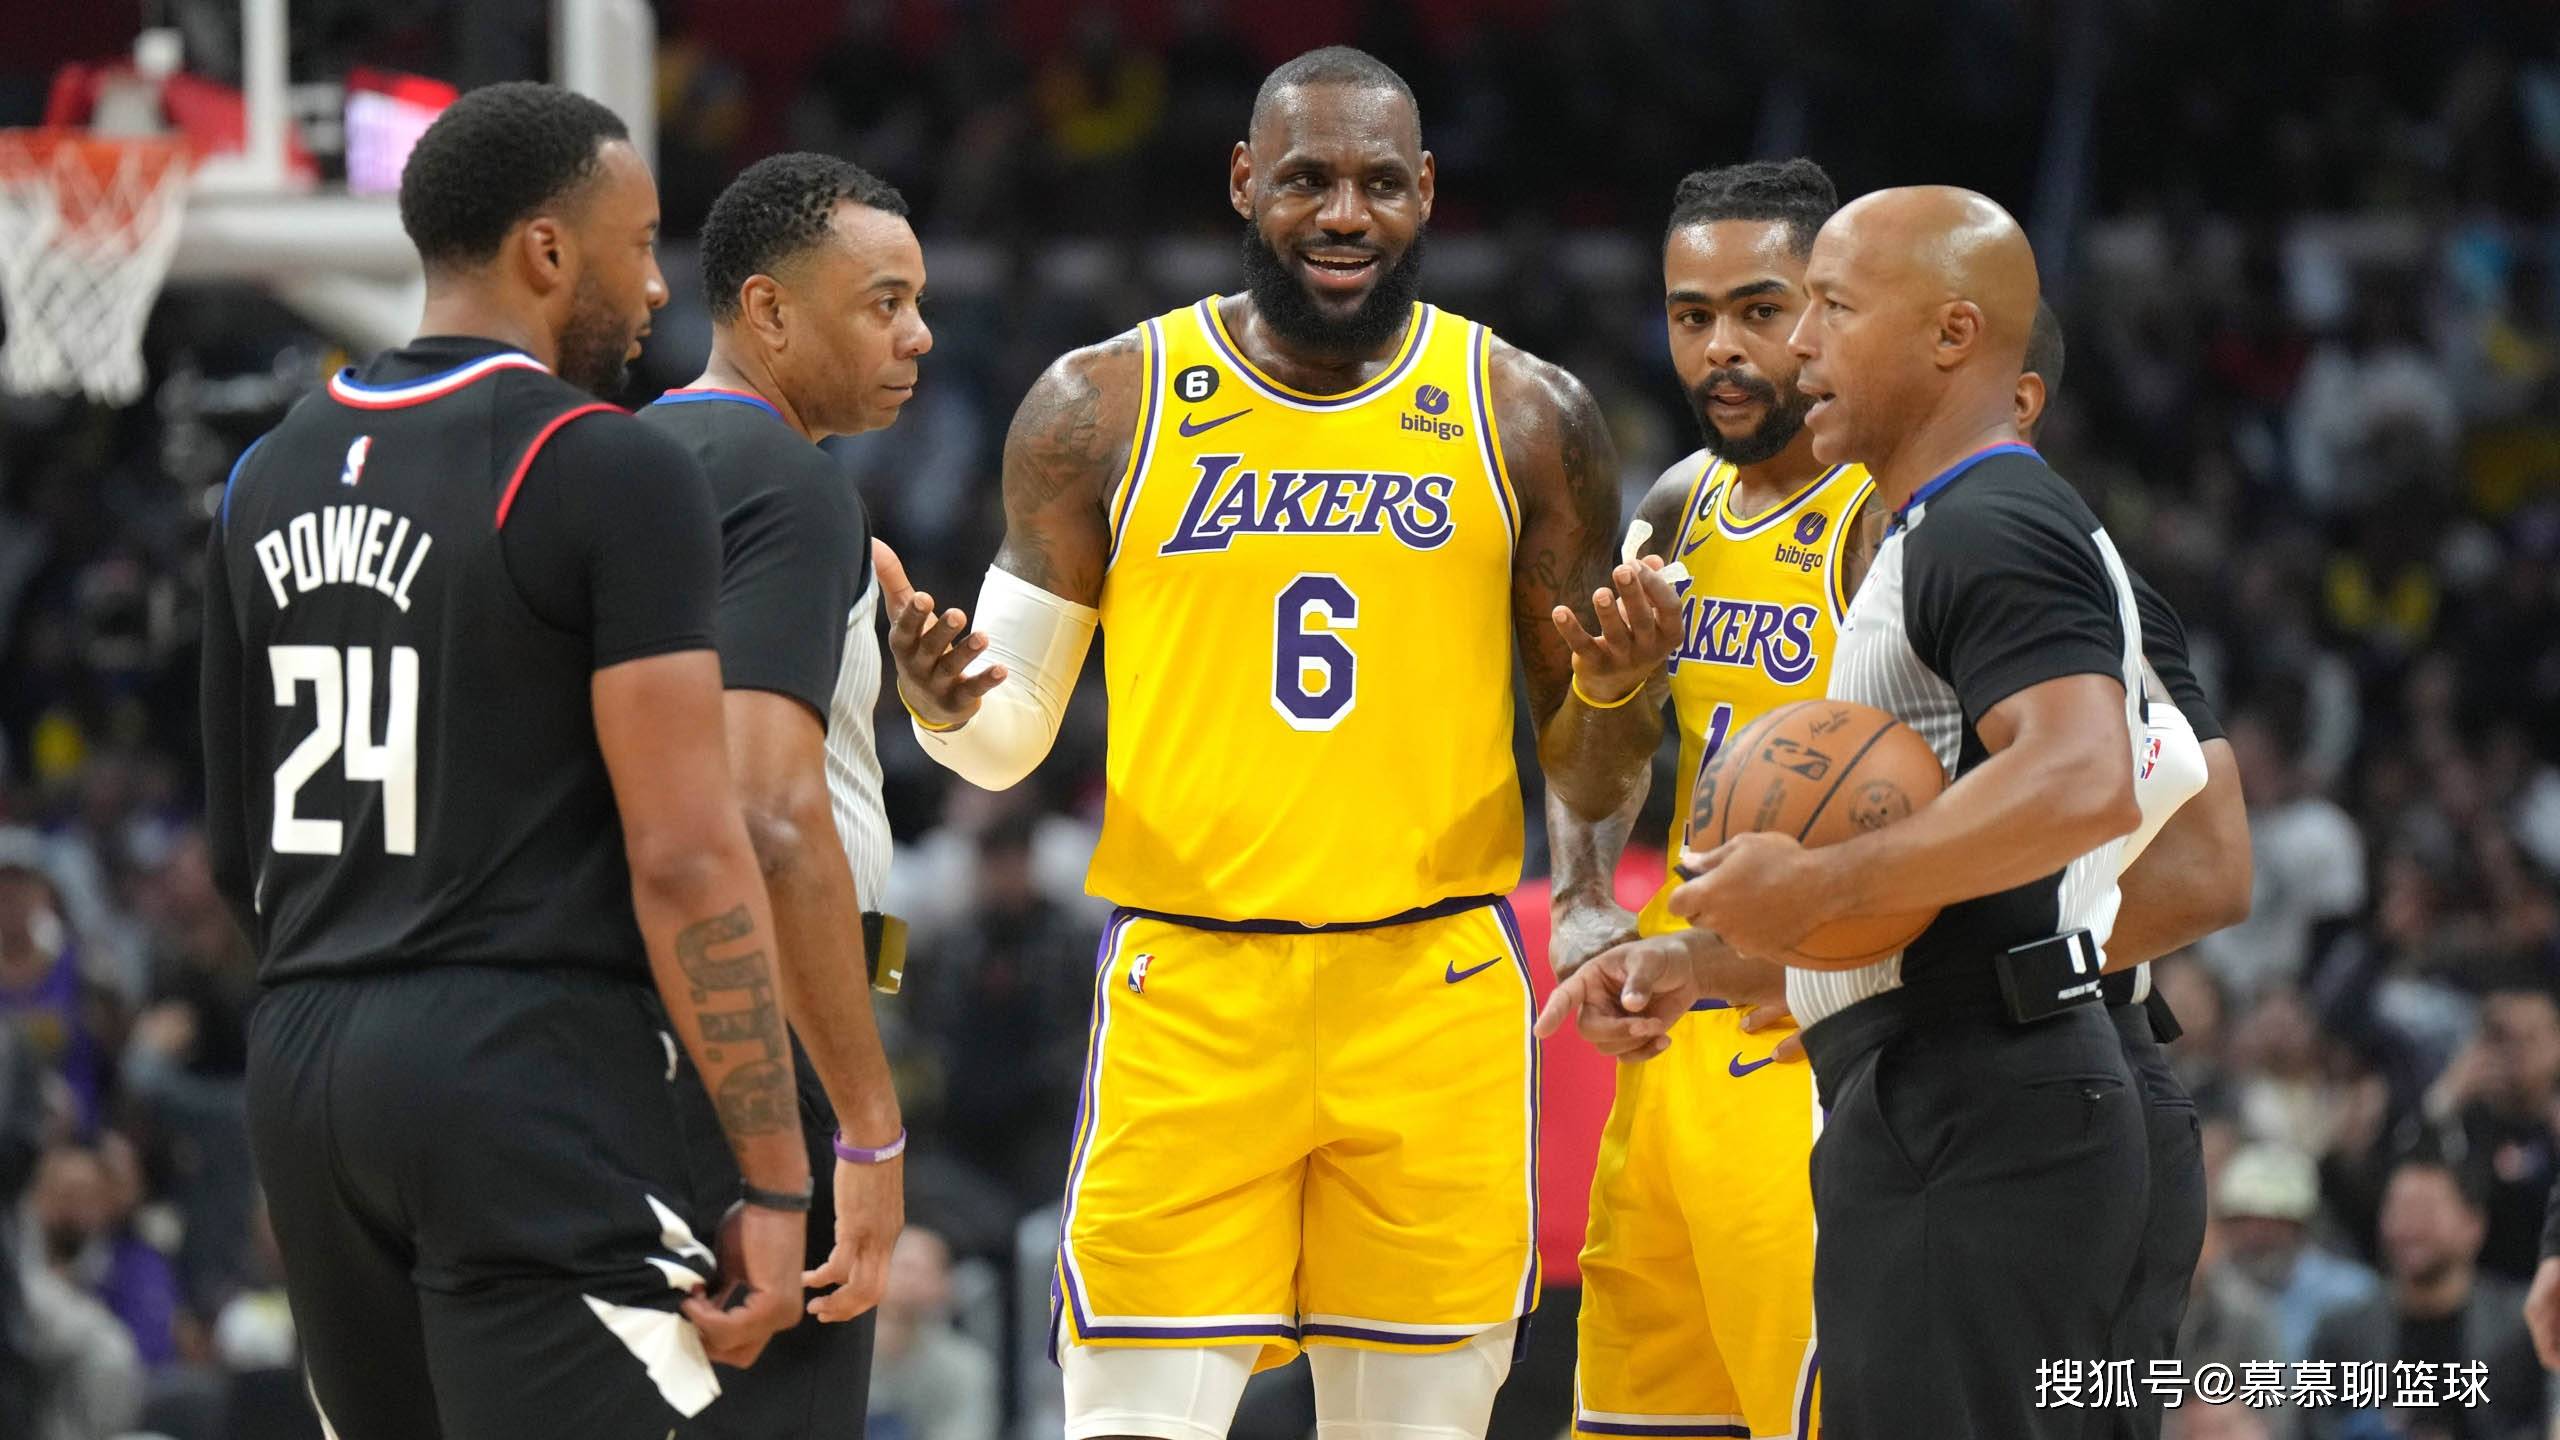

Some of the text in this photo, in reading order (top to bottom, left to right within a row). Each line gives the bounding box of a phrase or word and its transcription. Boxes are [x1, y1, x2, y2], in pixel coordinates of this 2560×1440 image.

[1185, 369, 1209, 399] 6
[1401, 411, 1464, 441] bibigo
[1158, 453, 1456, 556] LAKERS
[255, 505, 432, 612] POWELL
[1775, 543, 1824, 573] bibigo
[1271, 572, 1359, 731] 6
[268, 645, 419, 855] 24
